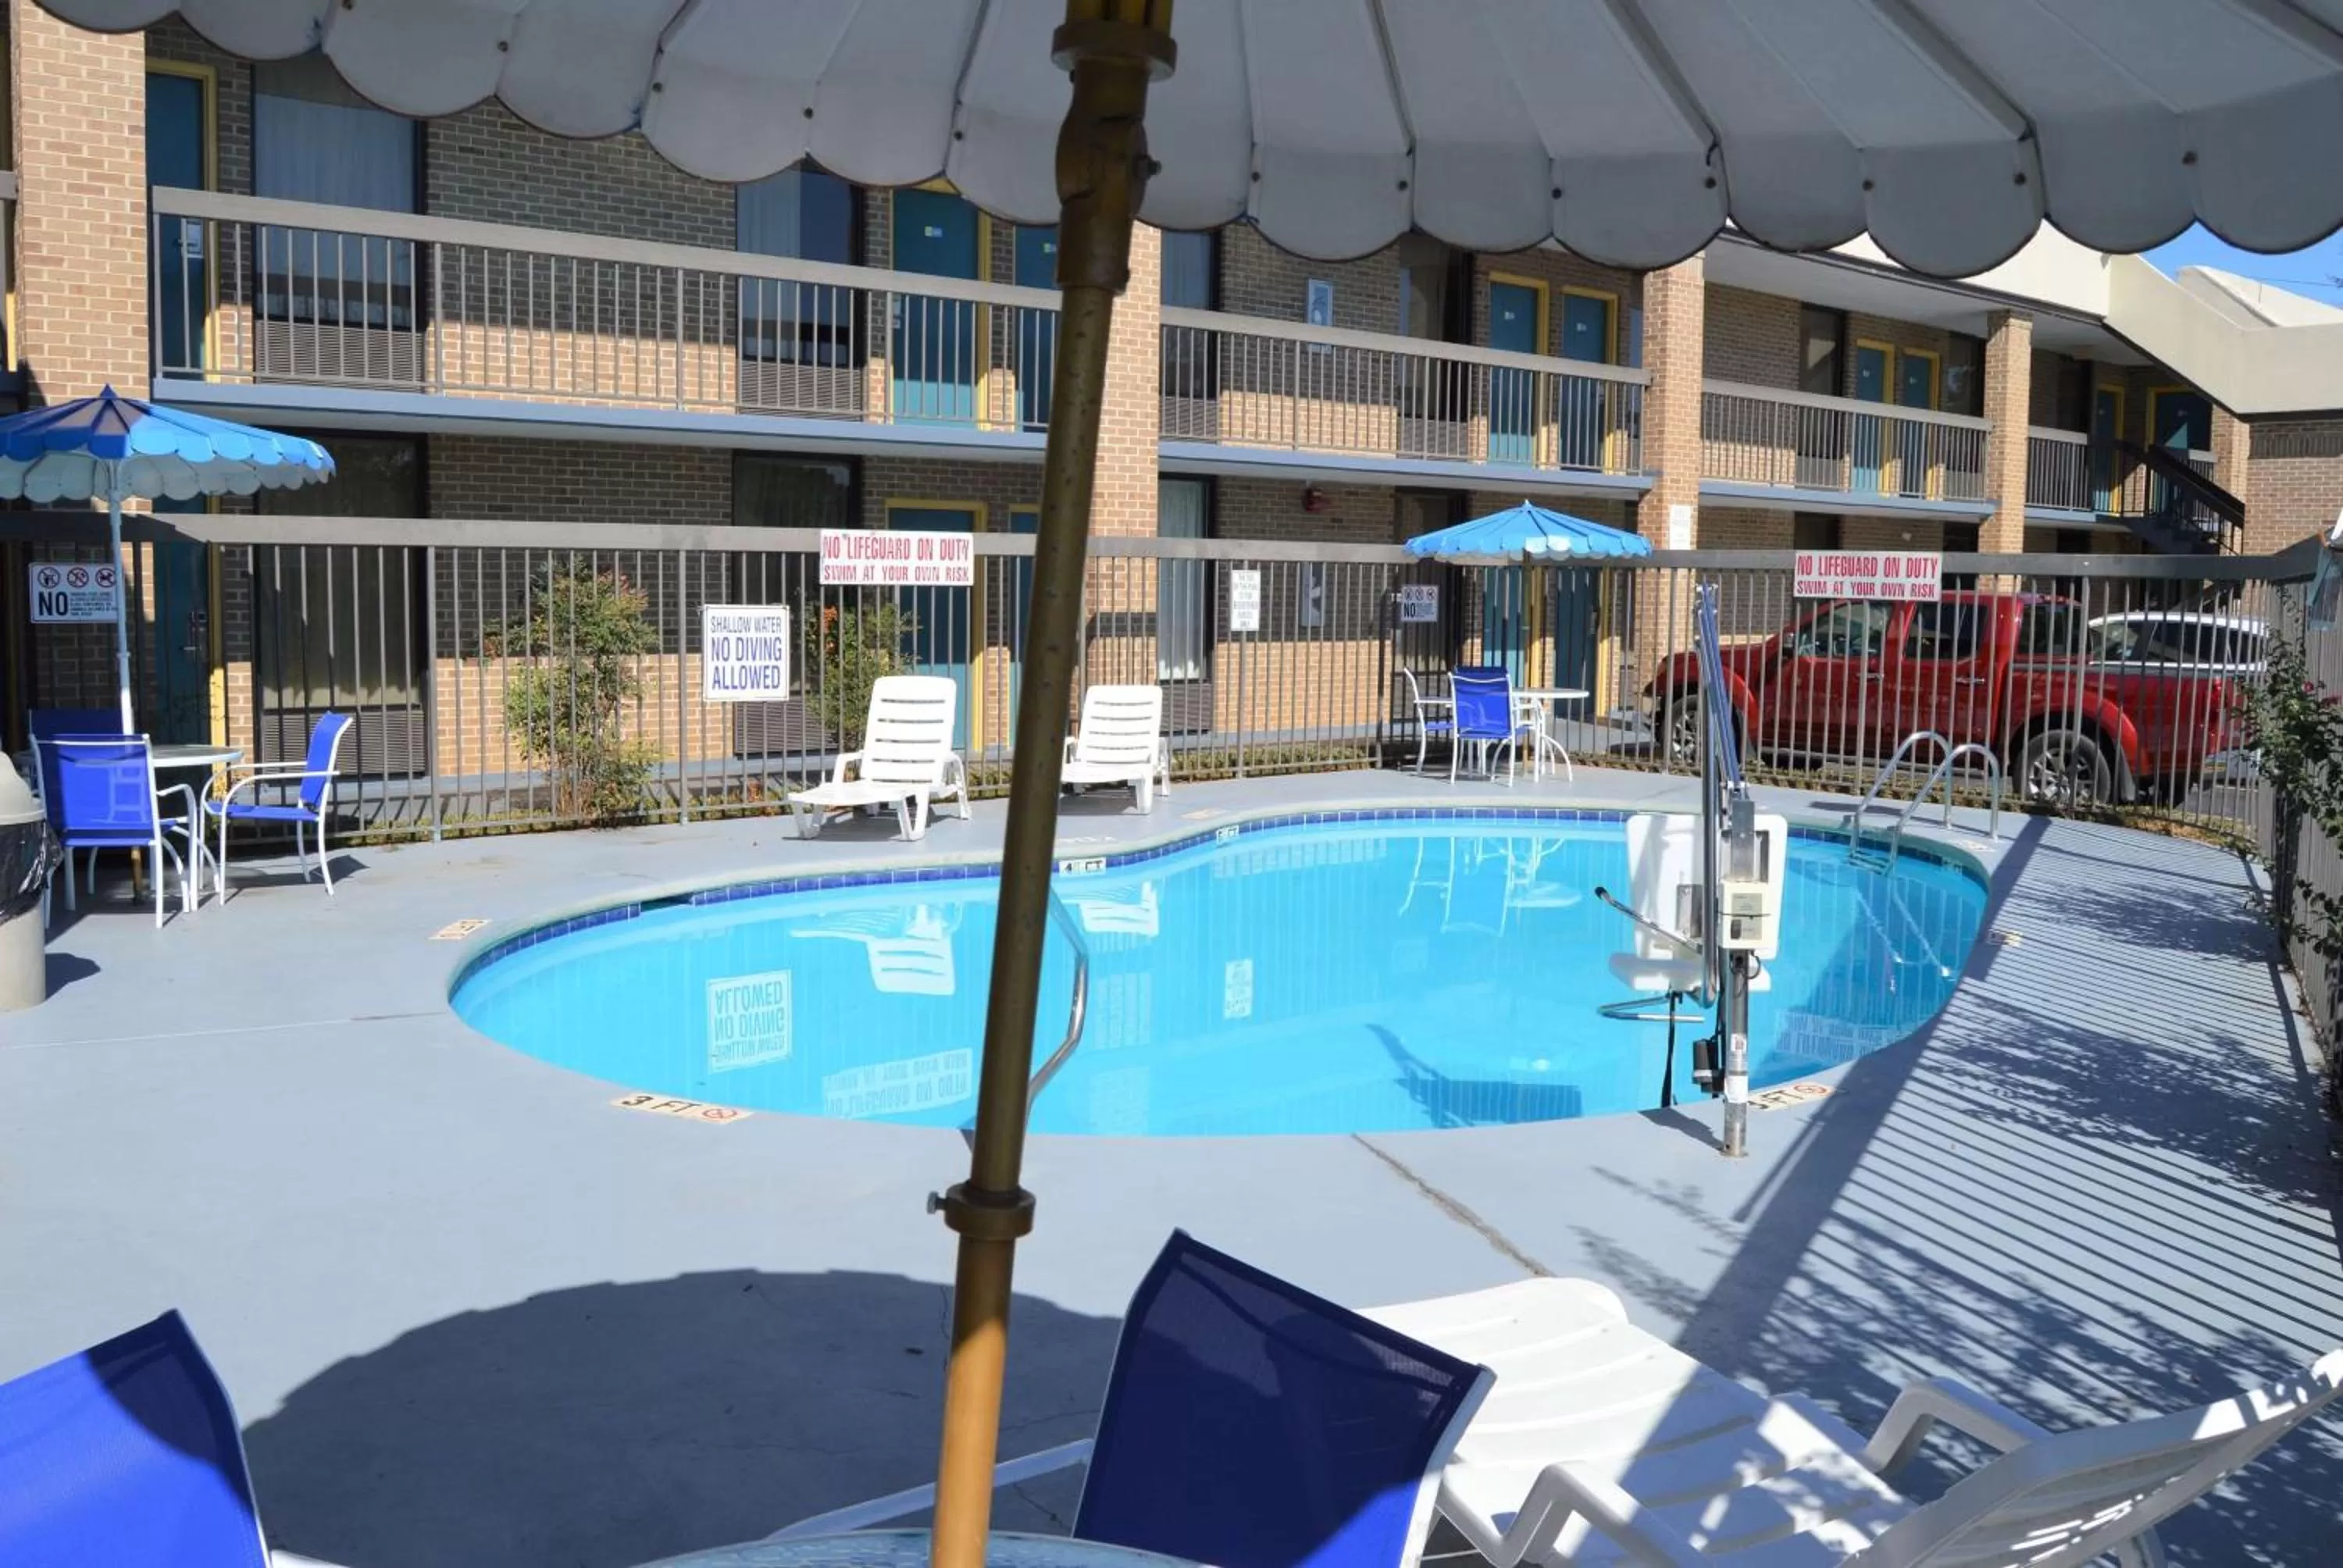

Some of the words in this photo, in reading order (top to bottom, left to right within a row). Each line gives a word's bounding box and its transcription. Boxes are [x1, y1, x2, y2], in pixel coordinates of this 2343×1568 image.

[822, 536, 840, 560] NO
[847, 536, 911, 560] LIFEGUARD
[917, 538, 933, 561] ON
[940, 538, 969, 561] DUTY
[824, 565, 857, 581] SWIM
[863, 565, 875, 581] AT
[882, 565, 908, 581] YOUR
[915, 566, 940, 581] OWN
[946, 566, 969, 582] RISK
[1797, 555, 1813, 576] NO
[1818, 555, 1878, 577] LIFEGUARD
[1884, 556, 1899, 578] ON
[1906, 556, 1938, 579] DUTY
[1796, 580, 1827, 594] SWIM
[1833, 580, 1844, 595] AT
[1850, 581, 1874, 596] YOUR
[1881, 582, 1905, 597] OWN
[1910, 583, 1935, 598] RISK
[38, 591, 68, 616] NO
[1403, 602, 1416, 618] NO
[711, 615, 751, 633] SHALLOW
[754, 616, 782, 633] WATER
[711, 636, 730, 661] NO
[736, 636, 782, 661] DIVING
[711, 665, 780, 690] ALLOWED
[622, 1096, 654, 1106] 3
[651, 1100, 702, 1113] FT
